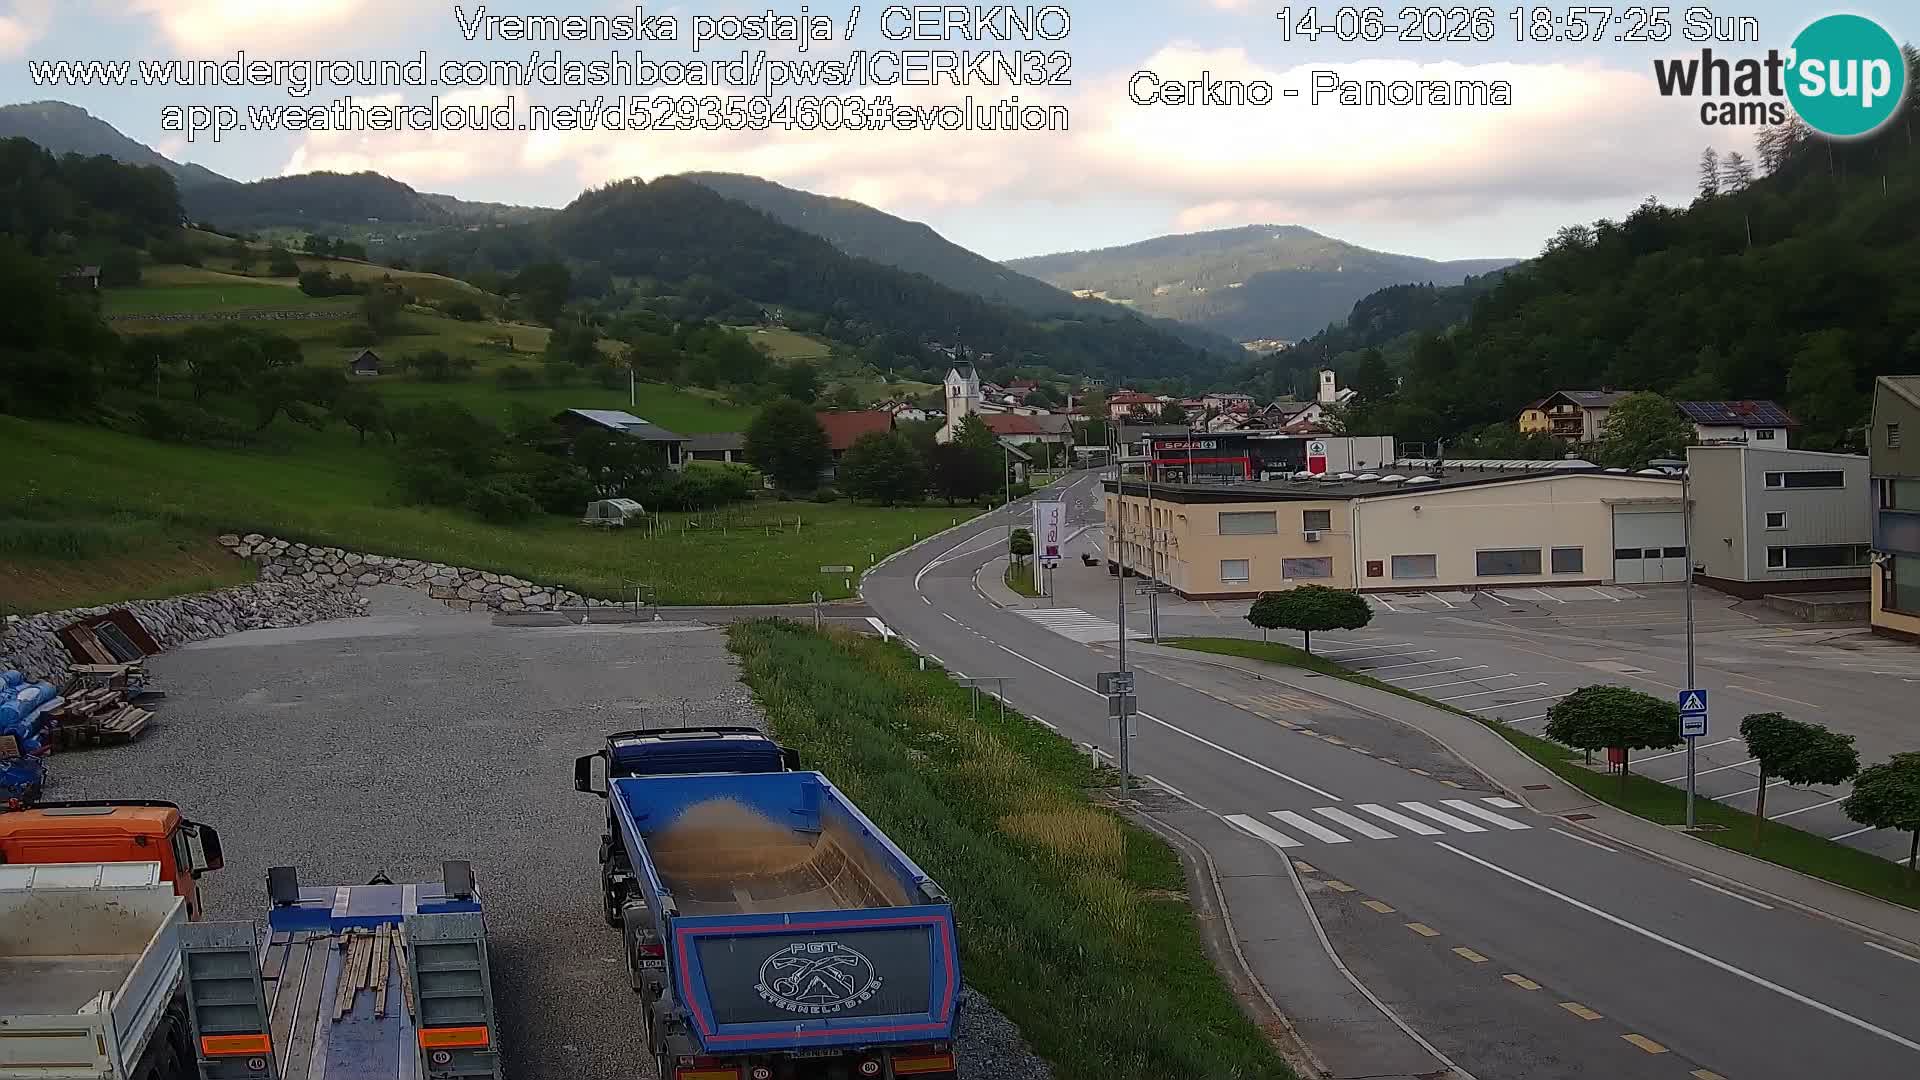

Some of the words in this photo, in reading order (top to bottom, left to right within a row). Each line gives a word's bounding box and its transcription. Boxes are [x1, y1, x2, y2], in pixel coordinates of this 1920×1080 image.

[1165, 441, 1200, 450] SPAR
[790, 942, 839, 955] PGT
[864, 1061, 876, 1072] 80
[756, 1068, 769, 1079] 70
